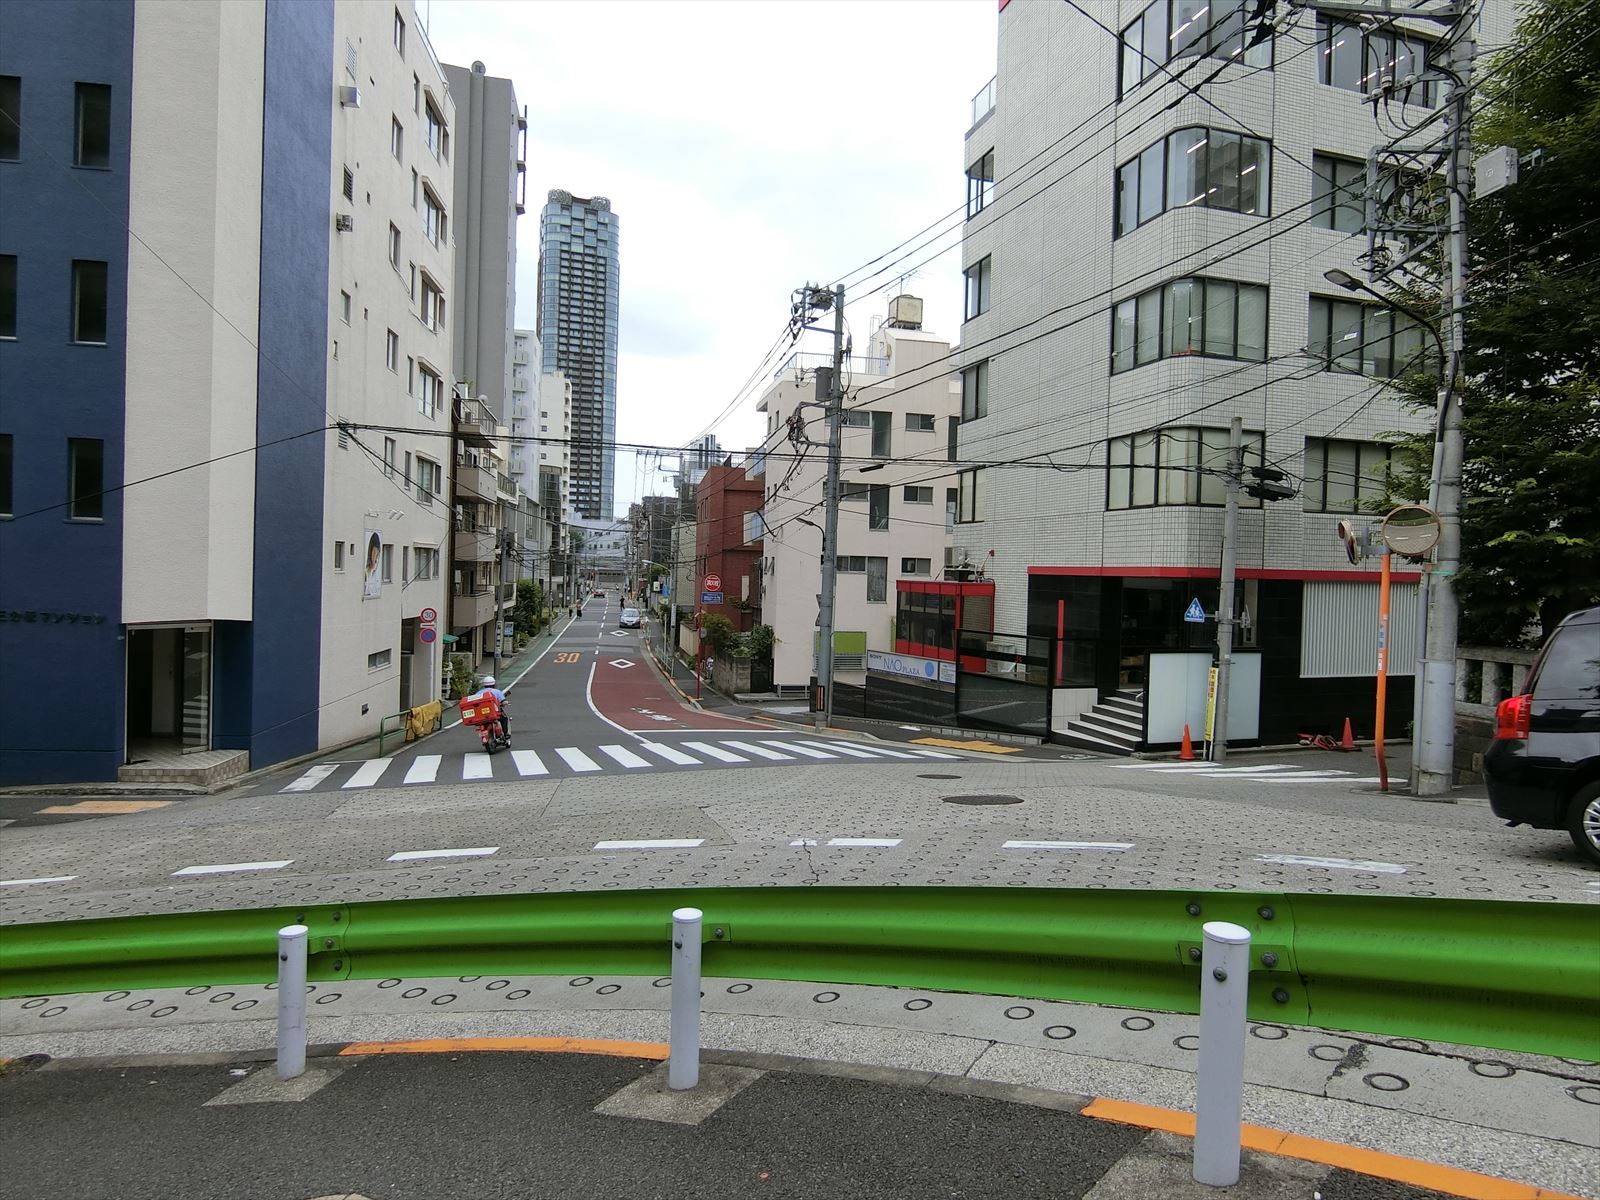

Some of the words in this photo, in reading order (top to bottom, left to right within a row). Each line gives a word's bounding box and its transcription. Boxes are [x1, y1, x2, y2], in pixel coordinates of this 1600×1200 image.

[424, 611, 434, 619] 30
[553, 652, 581, 664] 30
[902, 666, 920, 675] PLAZA
